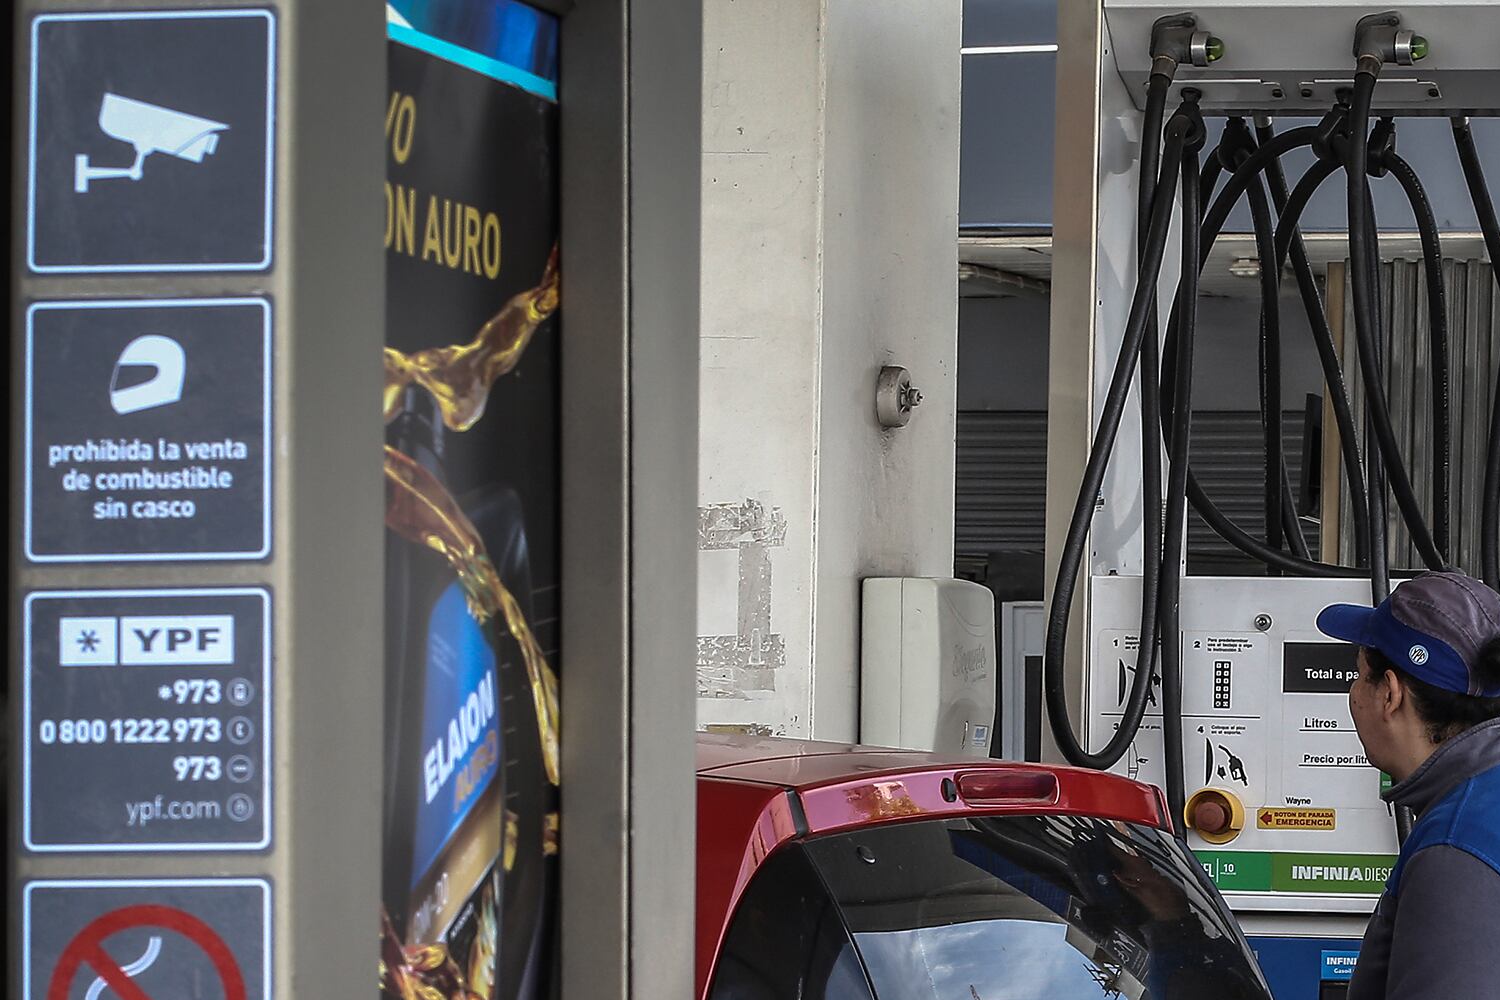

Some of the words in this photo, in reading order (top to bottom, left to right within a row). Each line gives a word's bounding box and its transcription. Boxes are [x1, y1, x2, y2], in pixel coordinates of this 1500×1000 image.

[421, 195, 501, 280] AURO
[48, 439, 154, 467] prohibida
[158, 438, 181, 461] la
[184, 439, 248, 461] venta
[62, 469, 91, 492] de
[95, 466, 233, 490] combustible
[93, 497, 127, 519] sin
[131, 500, 196, 519] casco
[132, 627, 220, 653] YPF
[1305, 668, 1333, 680] Total
[1335, 671, 1343, 680] a
[1304, 718, 1338, 728] Litros
[423, 669, 496, 805] ELAION
[172, 756, 222, 782] 973
[1303, 754, 1335, 764] Precio
[1337, 756, 1353, 766] por
[1355, 754, 1368, 764] litr
[126, 795, 221, 827] ypf.com
[1286, 796, 1311, 806] Wayne
[1275, 818, 1332, 827] EMERGENCIA
[1223, 863, 1235, 872] 10
[1292, 865, 1363, 880] INFINIA
